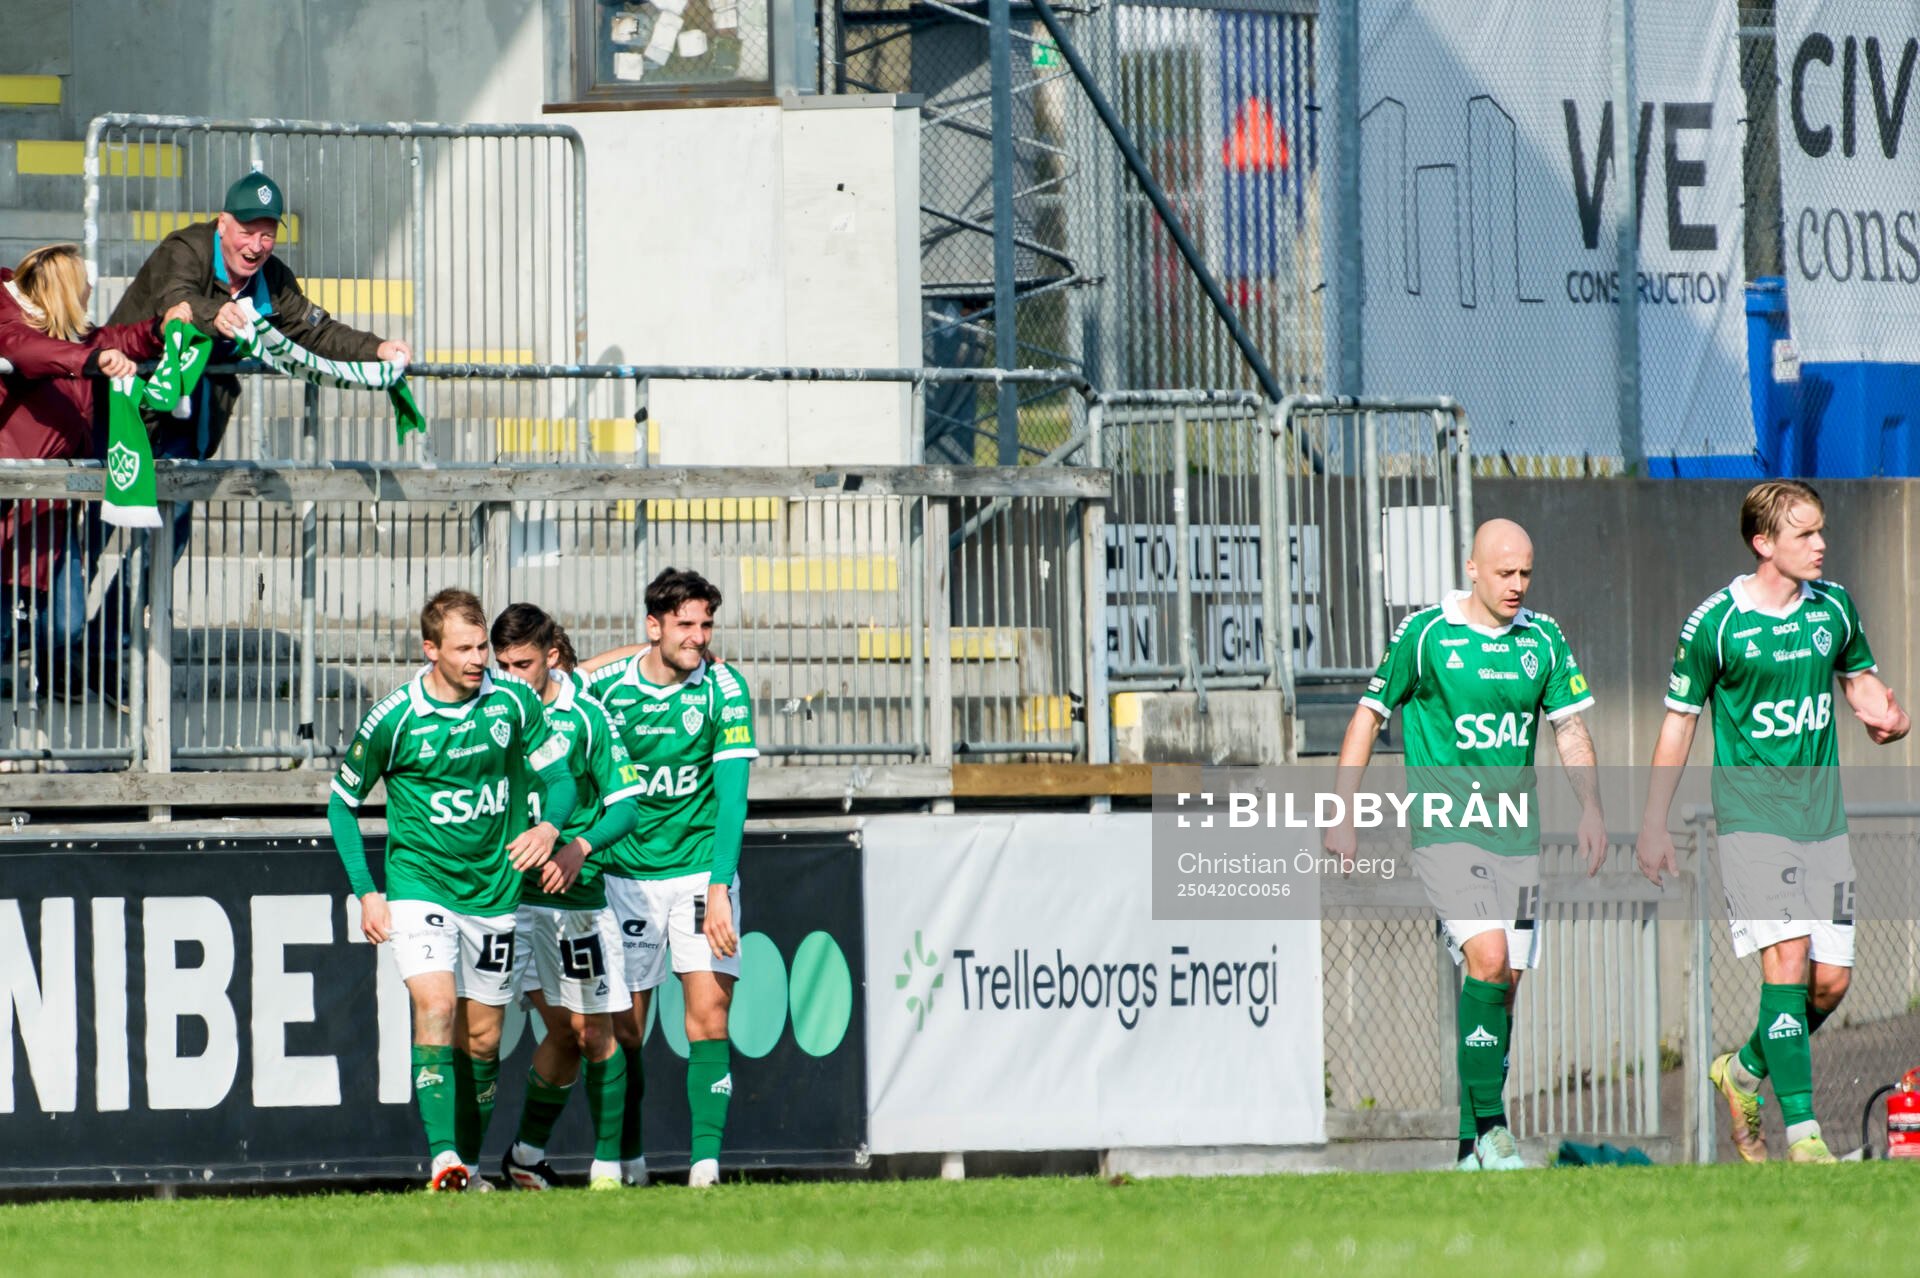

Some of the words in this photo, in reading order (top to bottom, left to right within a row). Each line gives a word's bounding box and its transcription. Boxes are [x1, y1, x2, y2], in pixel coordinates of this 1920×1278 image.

[1791, 32, 1920, 160] CIV
[1563, 98, 1718, 251] WE
[1798, 205, 1920, 283] cons
[1567, 270, 1729, 304] CONSRUCTIO
[1751, 692, 1832, 739] SSAB
[724, 725, 751, 744] XXL
[632, 763, 700, 797] SAB
[1780, 906, 1792, 925] 3
[422, 944, 435, 960] 2
[953, 948, 1158, 1030] Trelleborgs
[1170, 943, 1279, 1028] Energi
[1465, 1039, 1499, 1048] SELECT
[1767, 1028, 1803, 1040] SELECT
